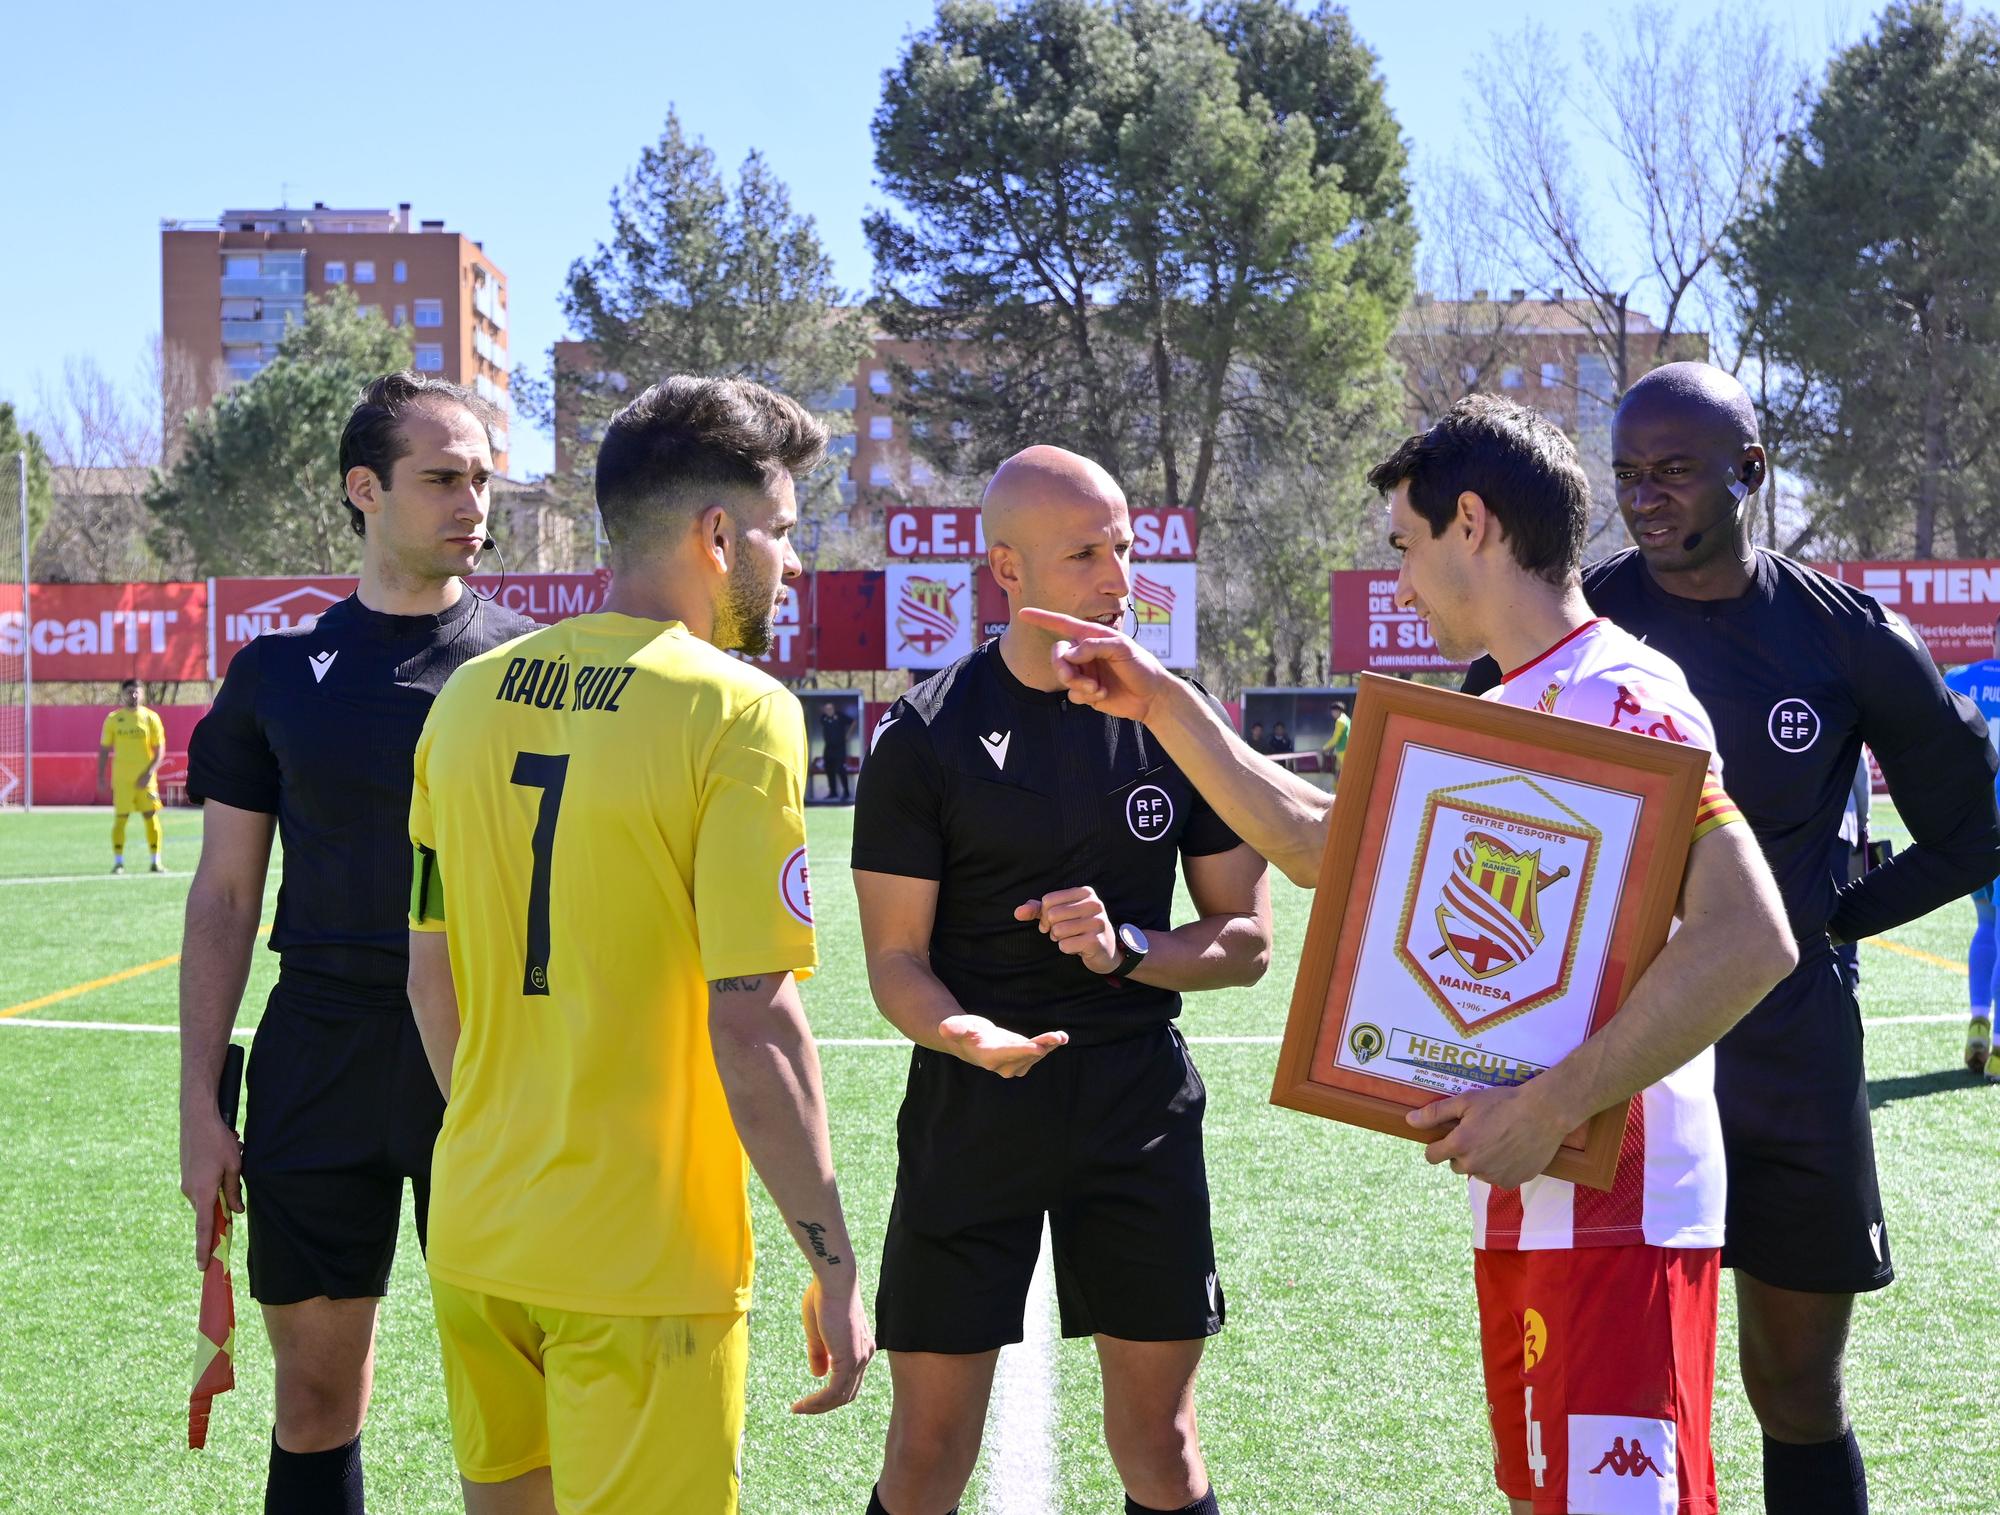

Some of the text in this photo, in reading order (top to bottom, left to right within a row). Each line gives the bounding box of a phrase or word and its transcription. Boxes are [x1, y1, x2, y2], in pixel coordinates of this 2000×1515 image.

[889, 514, 968, 554] C.E.
[1369, 597, 1392, 612] DE
[496, 655, 636, 712] RAÚL RUIZ
[1462, 813, 1567, 845] CENTRE D'ESPORTS
[510, 751, 570, 996] 7
[1481, 861, 1522, 877] MANRESA
[1439, 974, 1512, 1002] MANRESA
